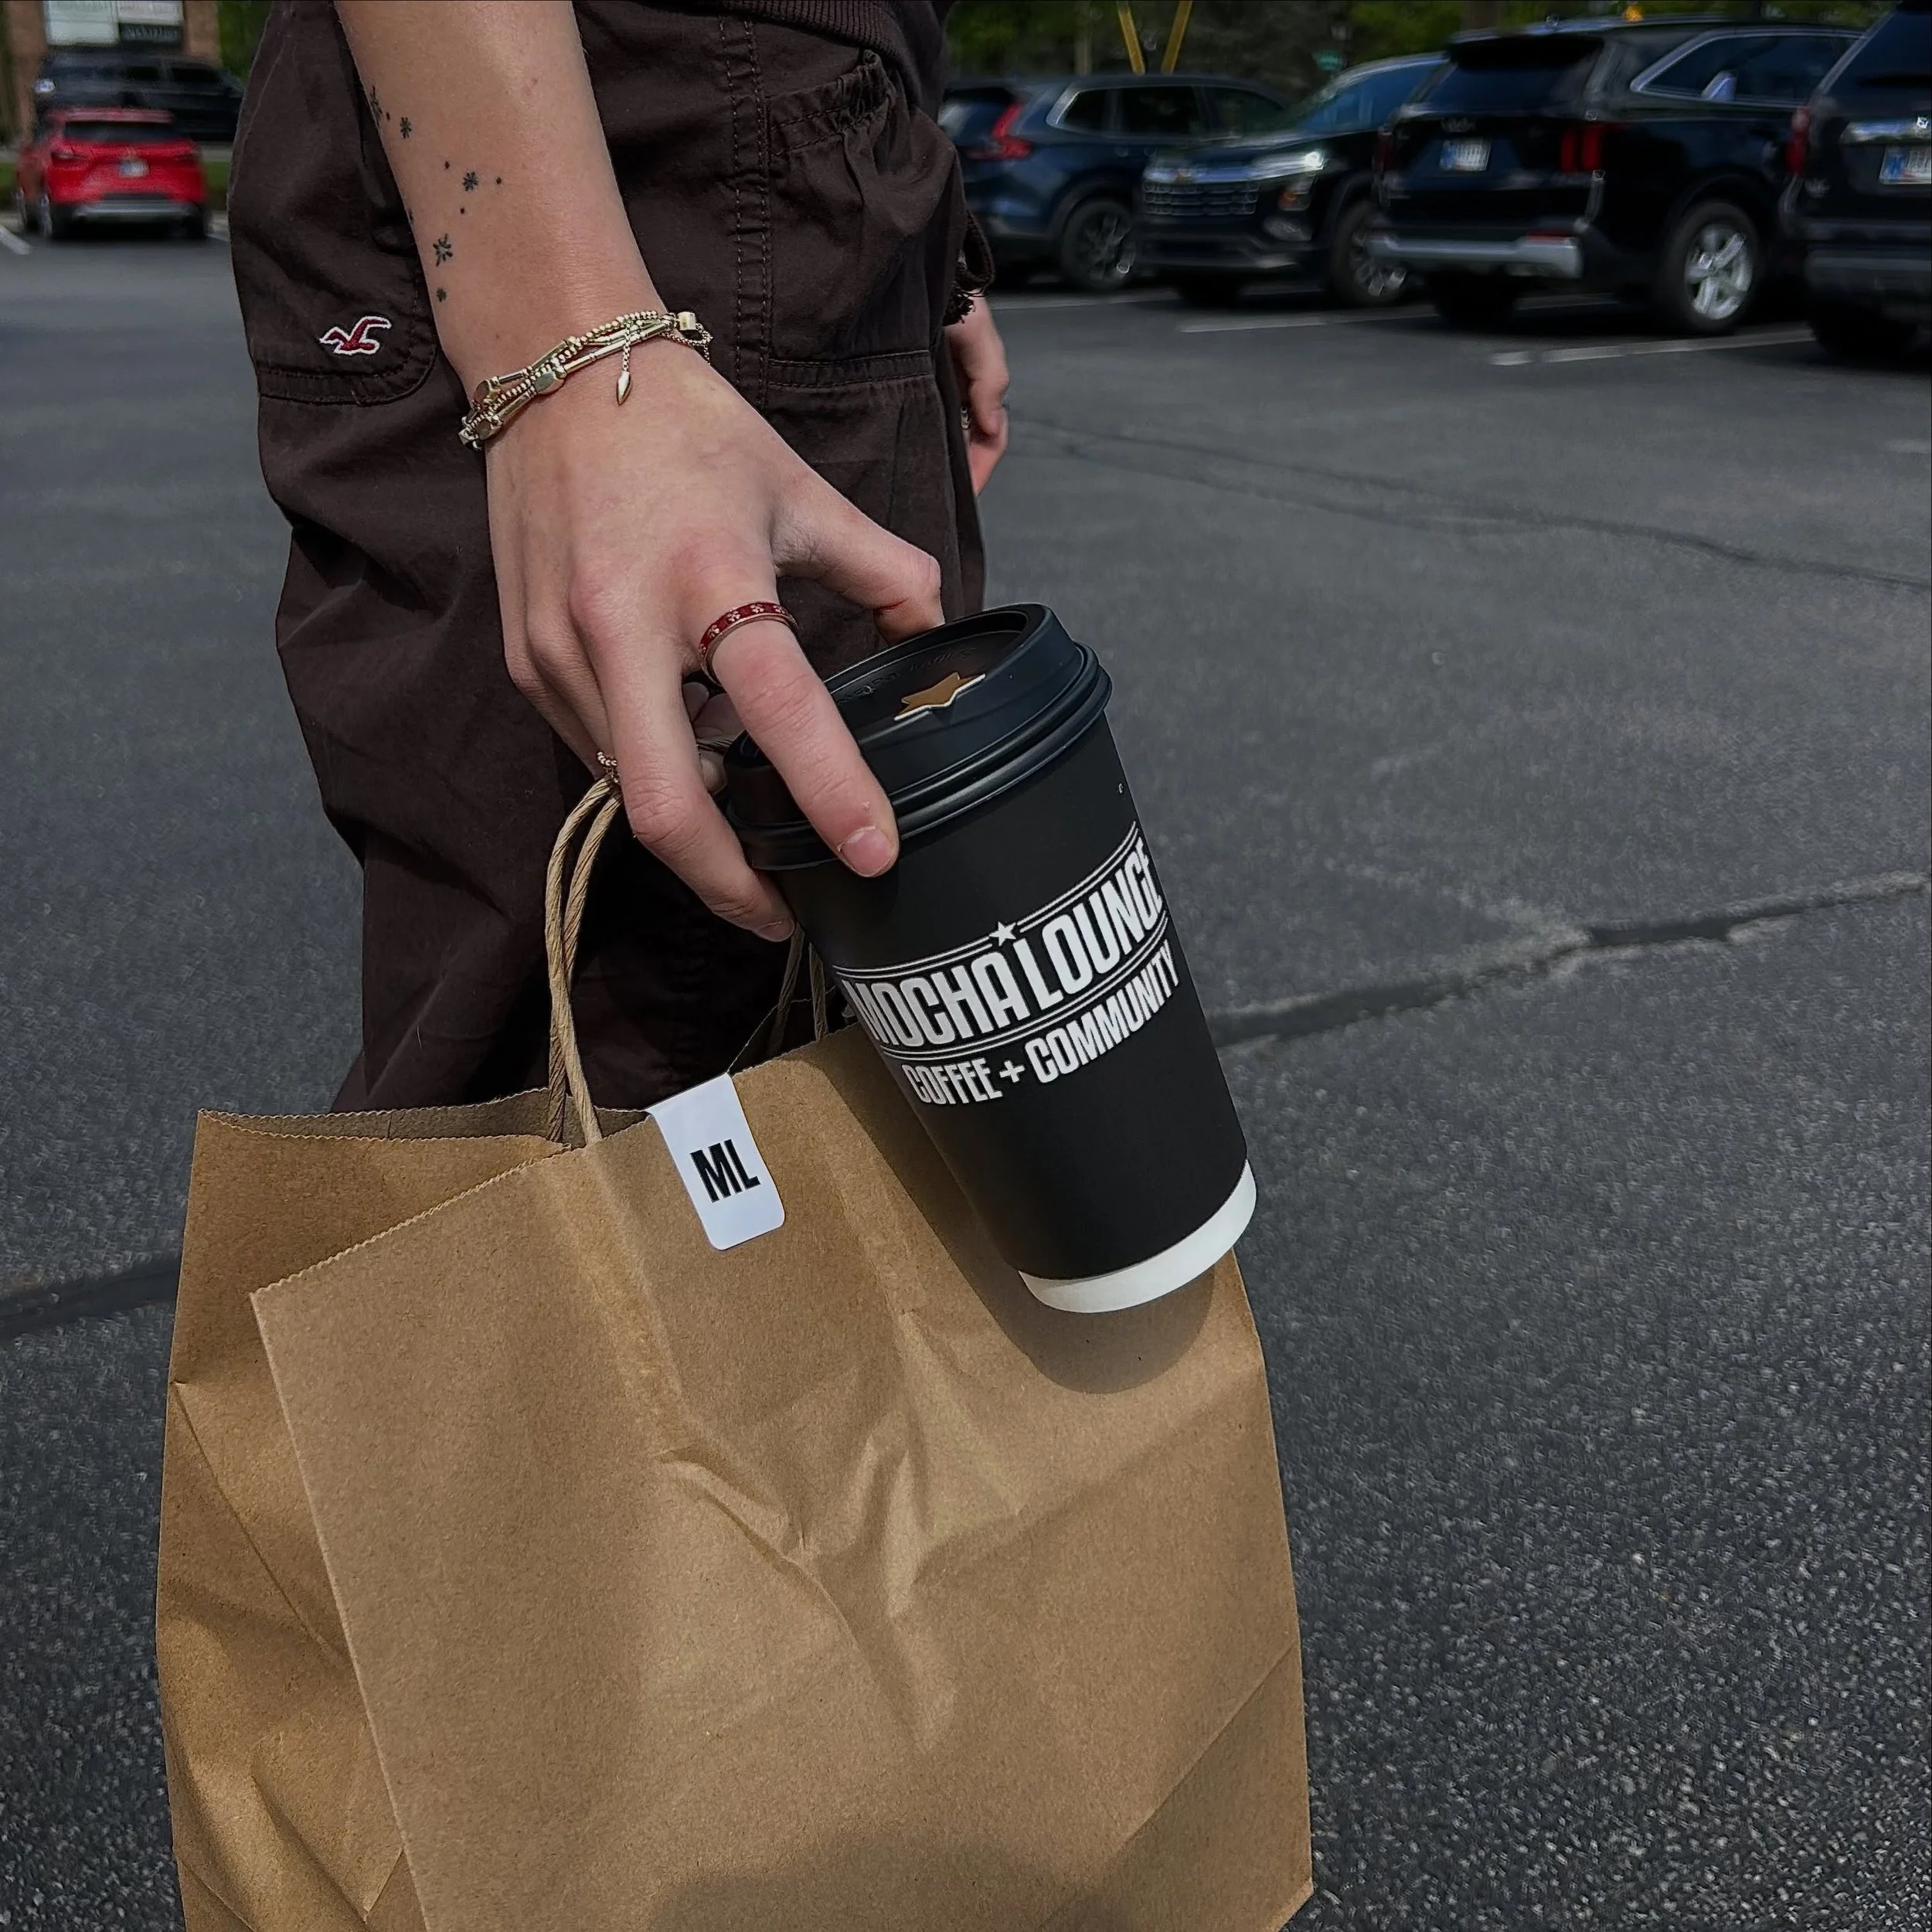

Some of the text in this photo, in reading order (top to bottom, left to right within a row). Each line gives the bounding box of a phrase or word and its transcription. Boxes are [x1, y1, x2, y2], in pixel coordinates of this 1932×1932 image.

[840, 836, 1163, 1047] MOCHA LOUNGE
[901, 938, 1181, 1105] COFFEE + COMMUNITY
[689, 1138, 761, 1203] ML
